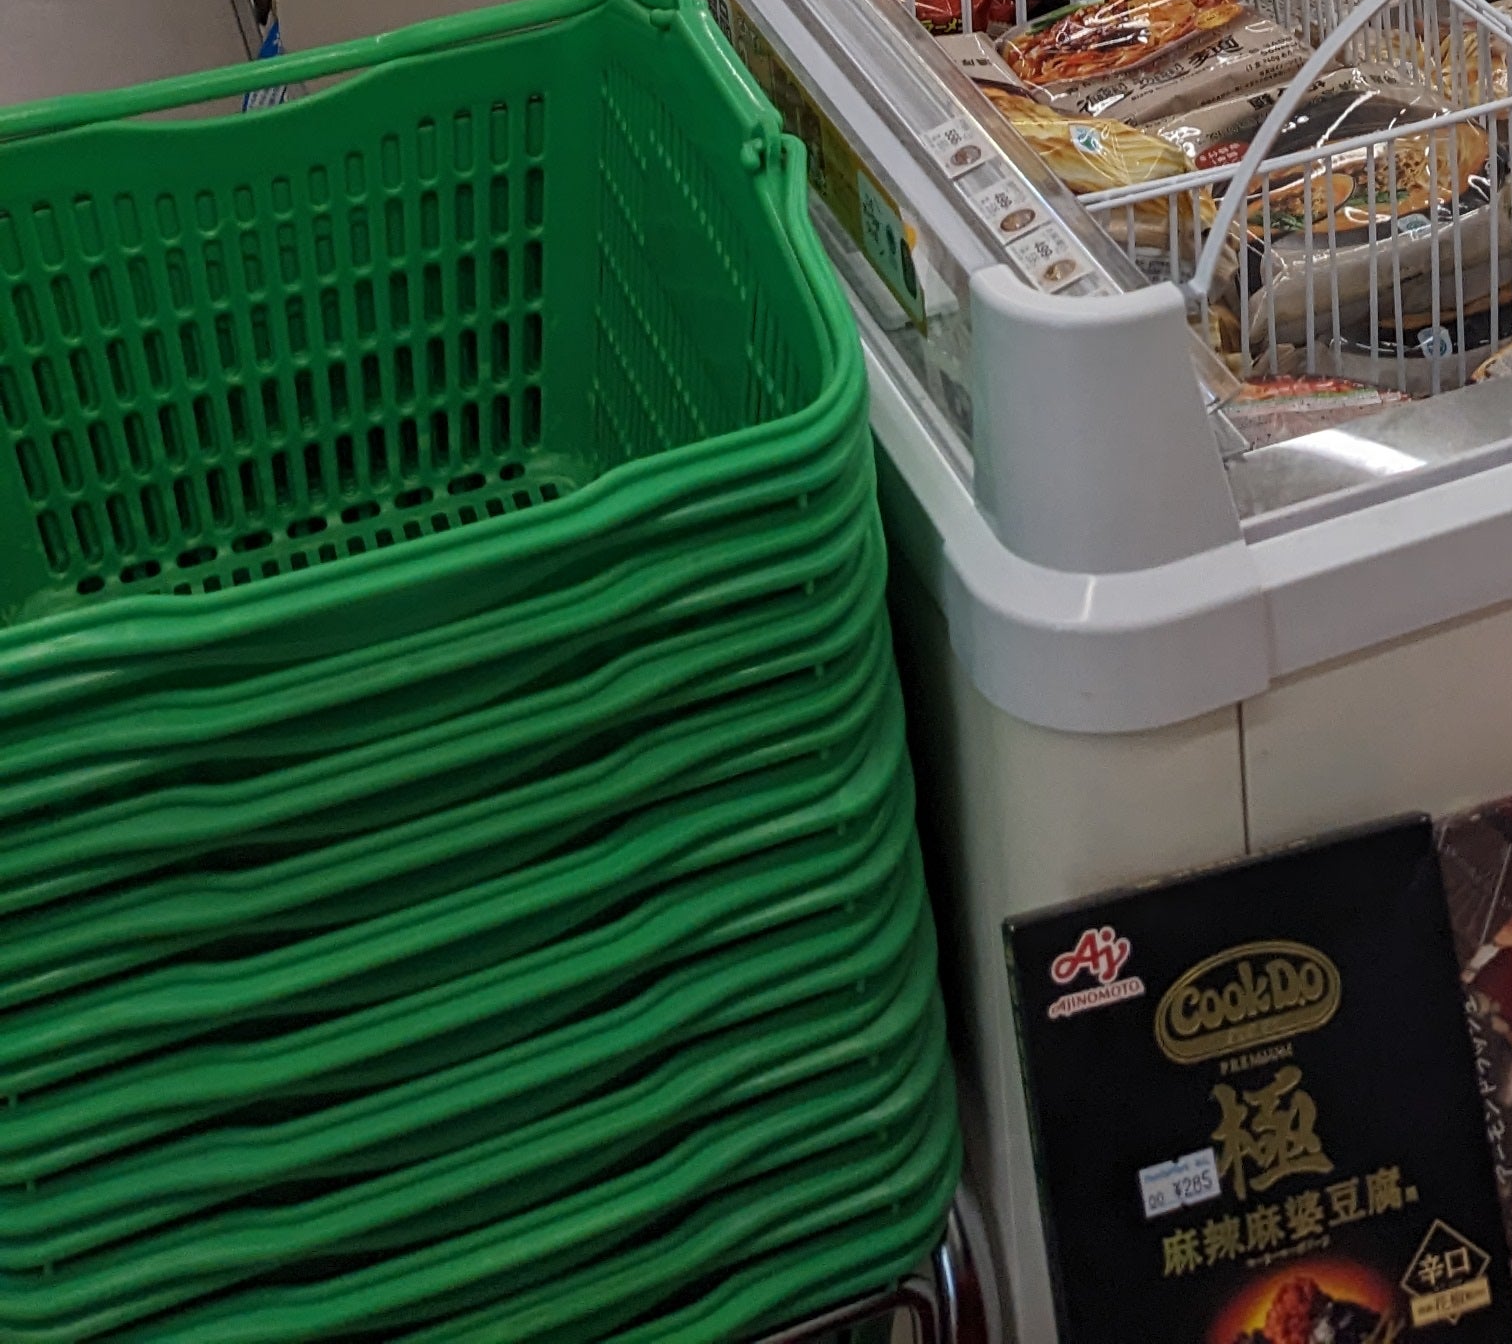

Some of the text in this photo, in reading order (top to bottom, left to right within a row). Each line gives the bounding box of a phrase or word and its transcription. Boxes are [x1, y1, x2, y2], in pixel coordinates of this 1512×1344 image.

[1049, 977, 1145, 1020] AJINOMOTO
[1208, 1065, 1336, 1200] 極
[1161, 1164, 1404, 1278] 麻辣麻婆豆腐
[1418, 1246, 1470, 1288] 辛口
